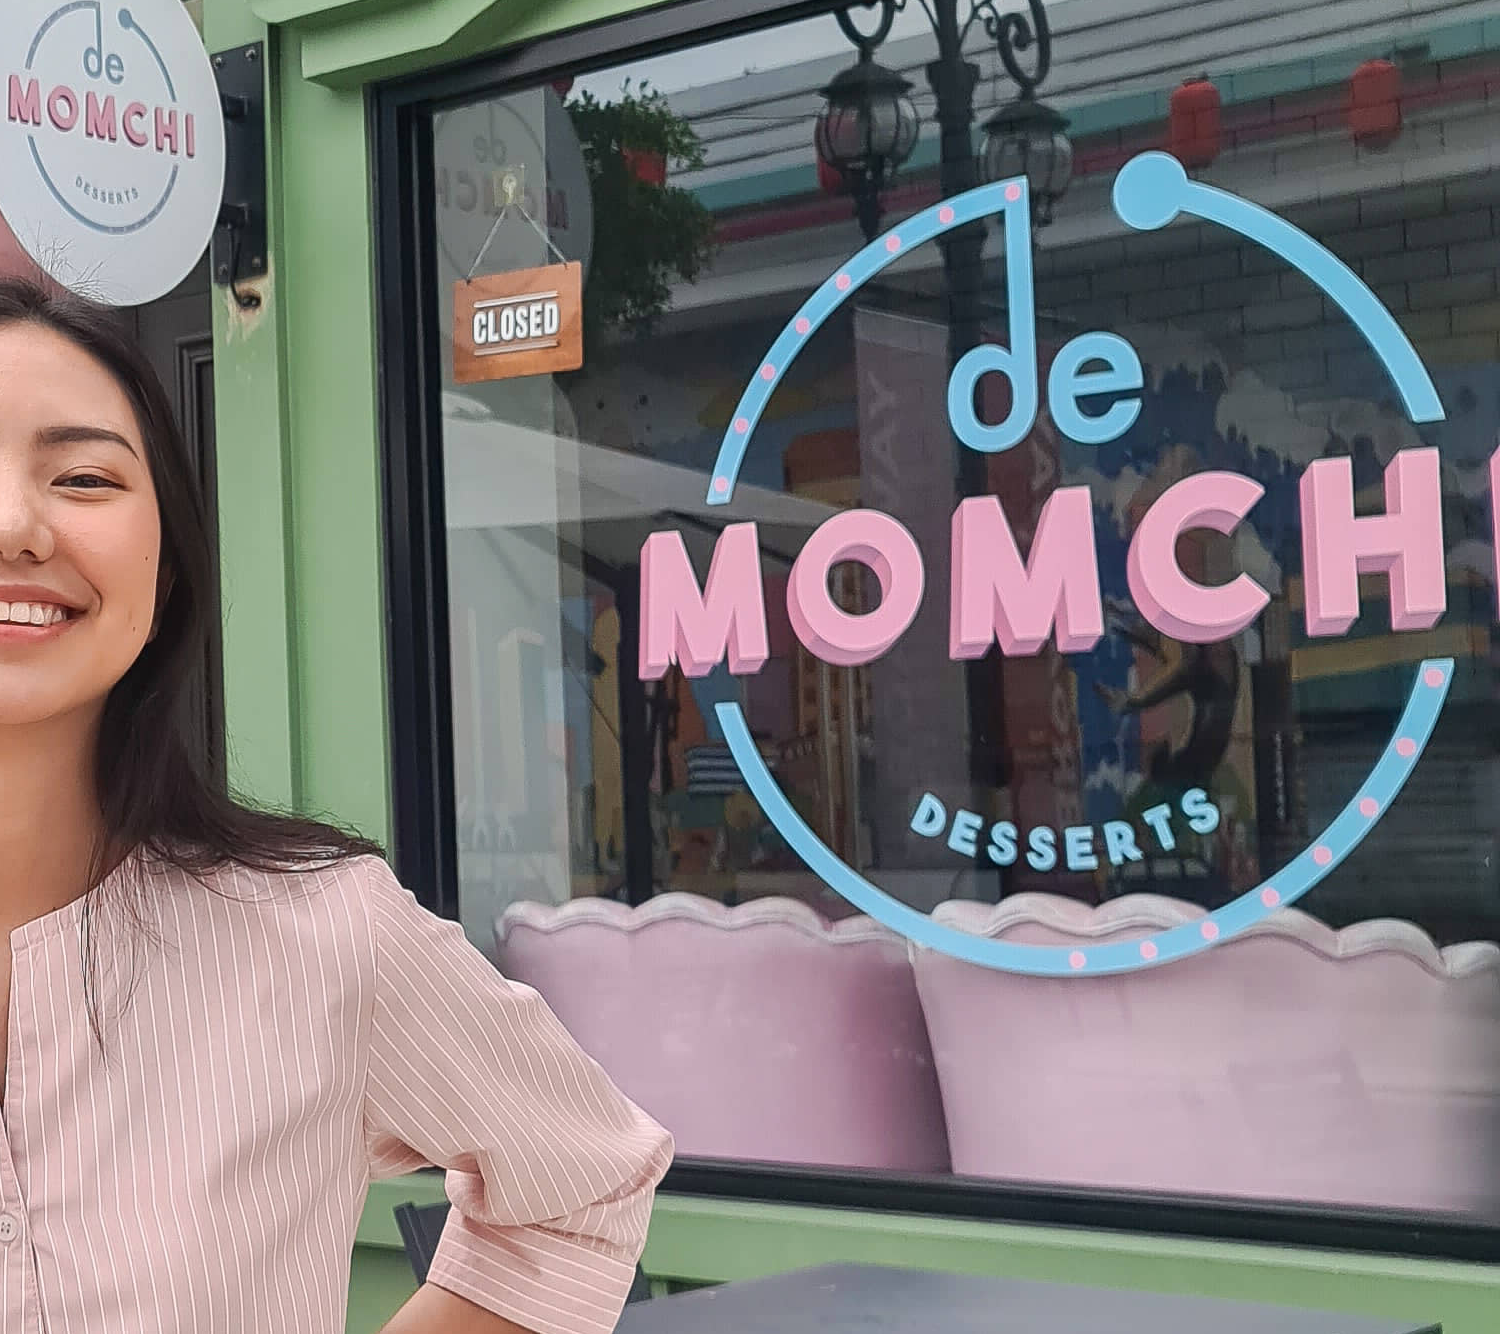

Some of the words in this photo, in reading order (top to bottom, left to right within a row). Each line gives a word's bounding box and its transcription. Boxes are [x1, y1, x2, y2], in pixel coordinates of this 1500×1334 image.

[7, 74, 196, 160] MOMCHI
[75, 176, 139, 205] DESSERTS
[472, 300, 560, 346] CLOSED
[638, 445, 1500, 680] MOMCH
[910, 786, 1220, 871] DESSERTS
